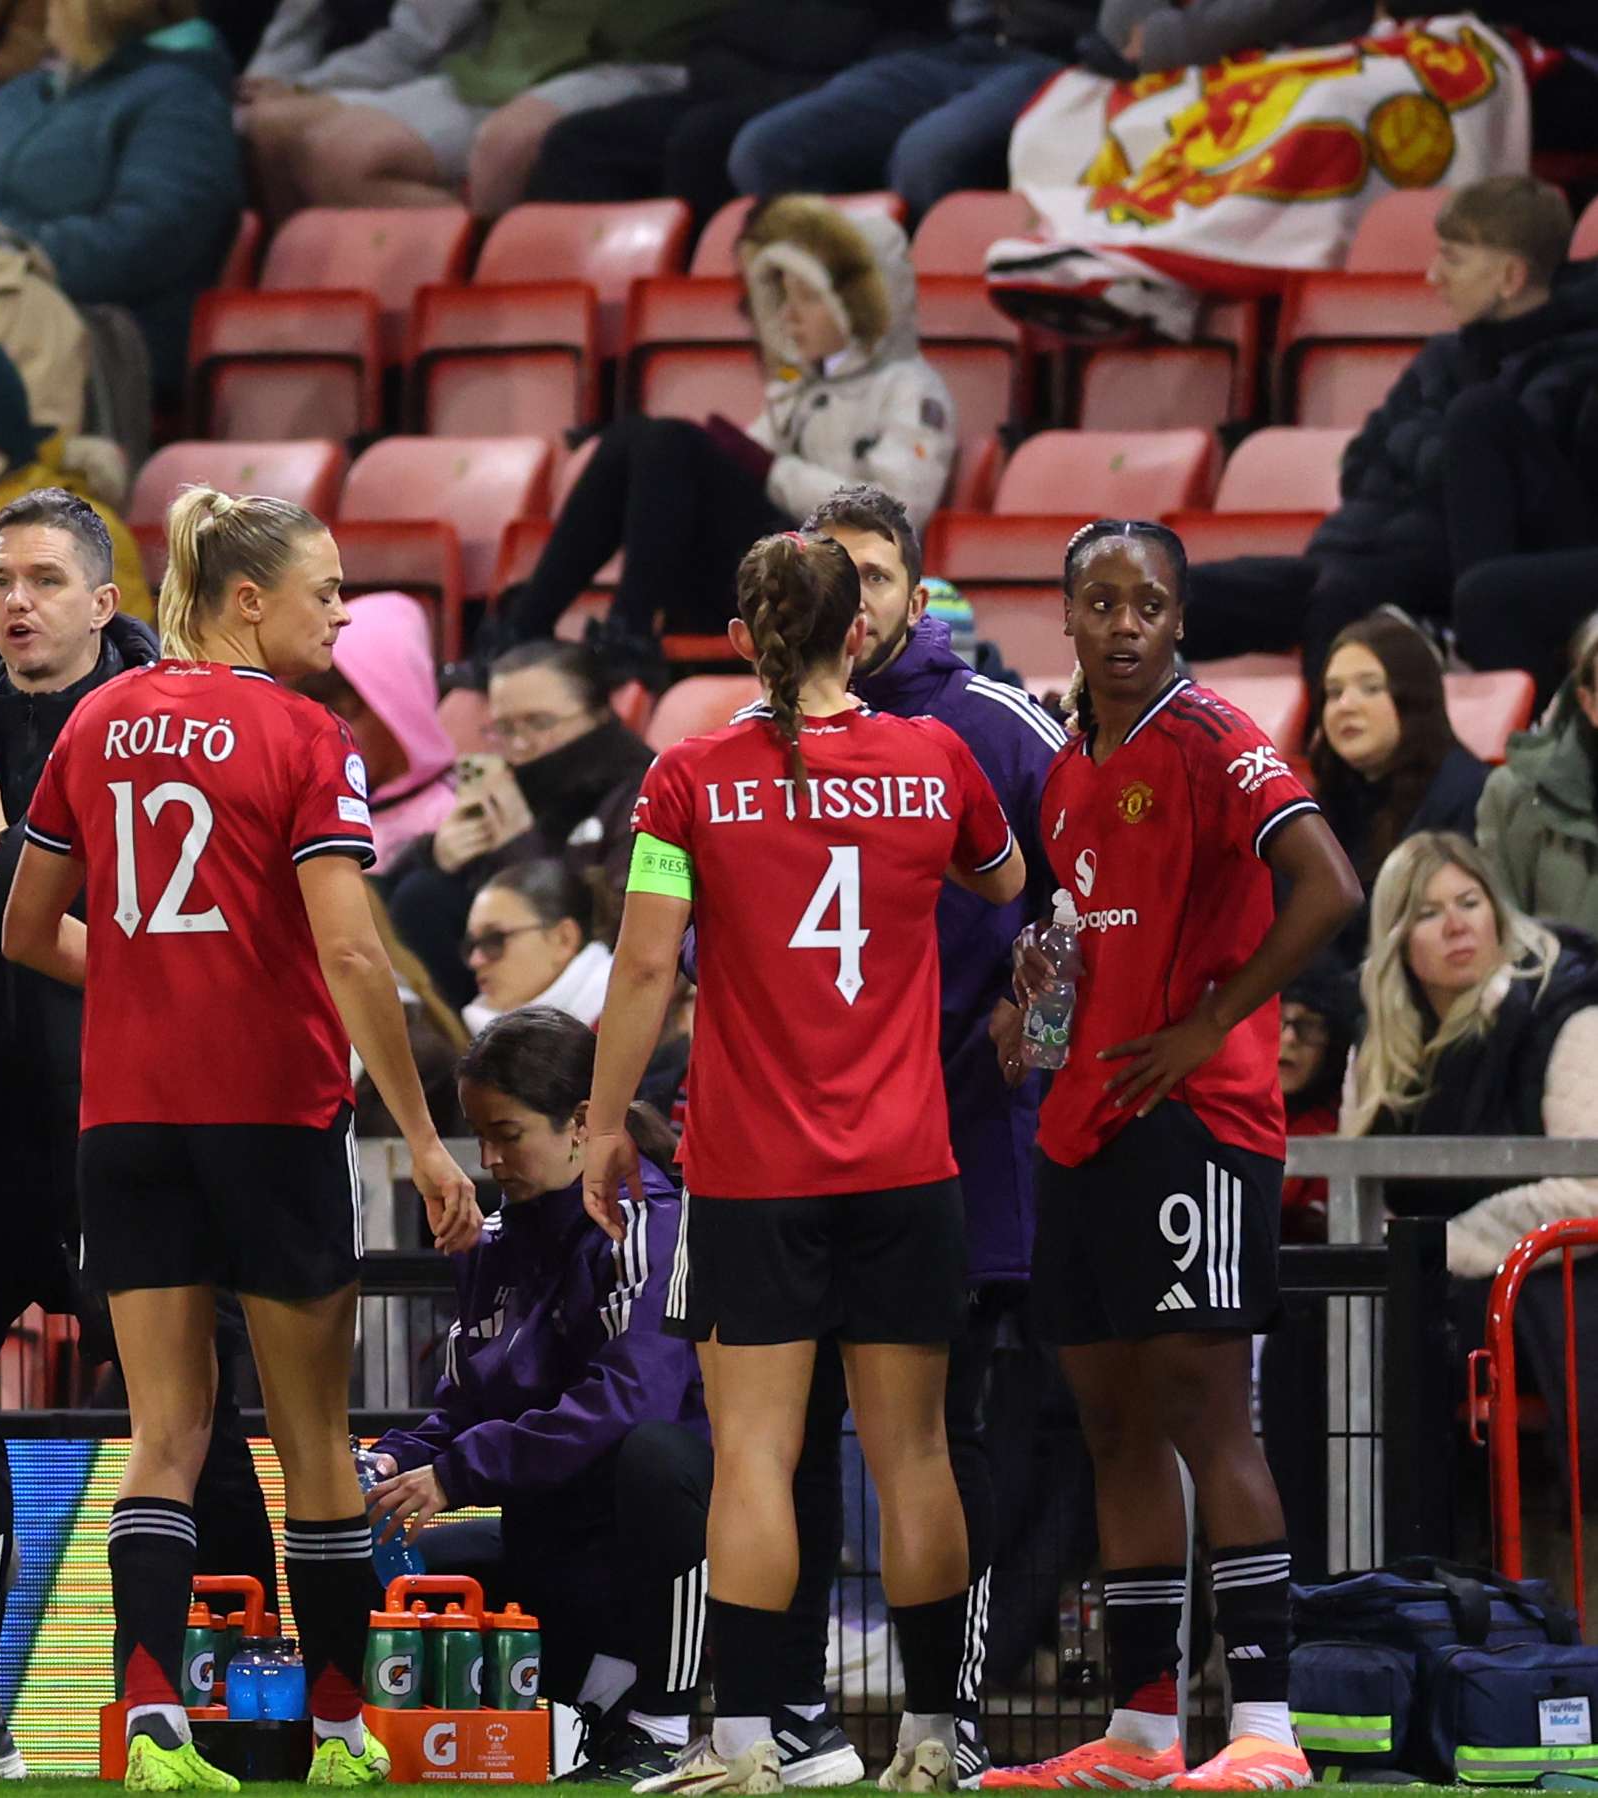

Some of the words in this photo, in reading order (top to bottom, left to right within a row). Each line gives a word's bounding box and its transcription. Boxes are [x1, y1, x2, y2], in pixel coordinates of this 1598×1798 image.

[104, 715, 235, 763] ROLFÖ
[706, 780, 763, 823] LE
[774, 776, 952, 821] TISSIER
[107, 781, 230, 940] 12
[788, 845, 871, 1006] 4
[1158, 1192, 1202, 1273] 9
[377, 1655, 413, 1697] G
[422, 1721, 458, 1767] G
